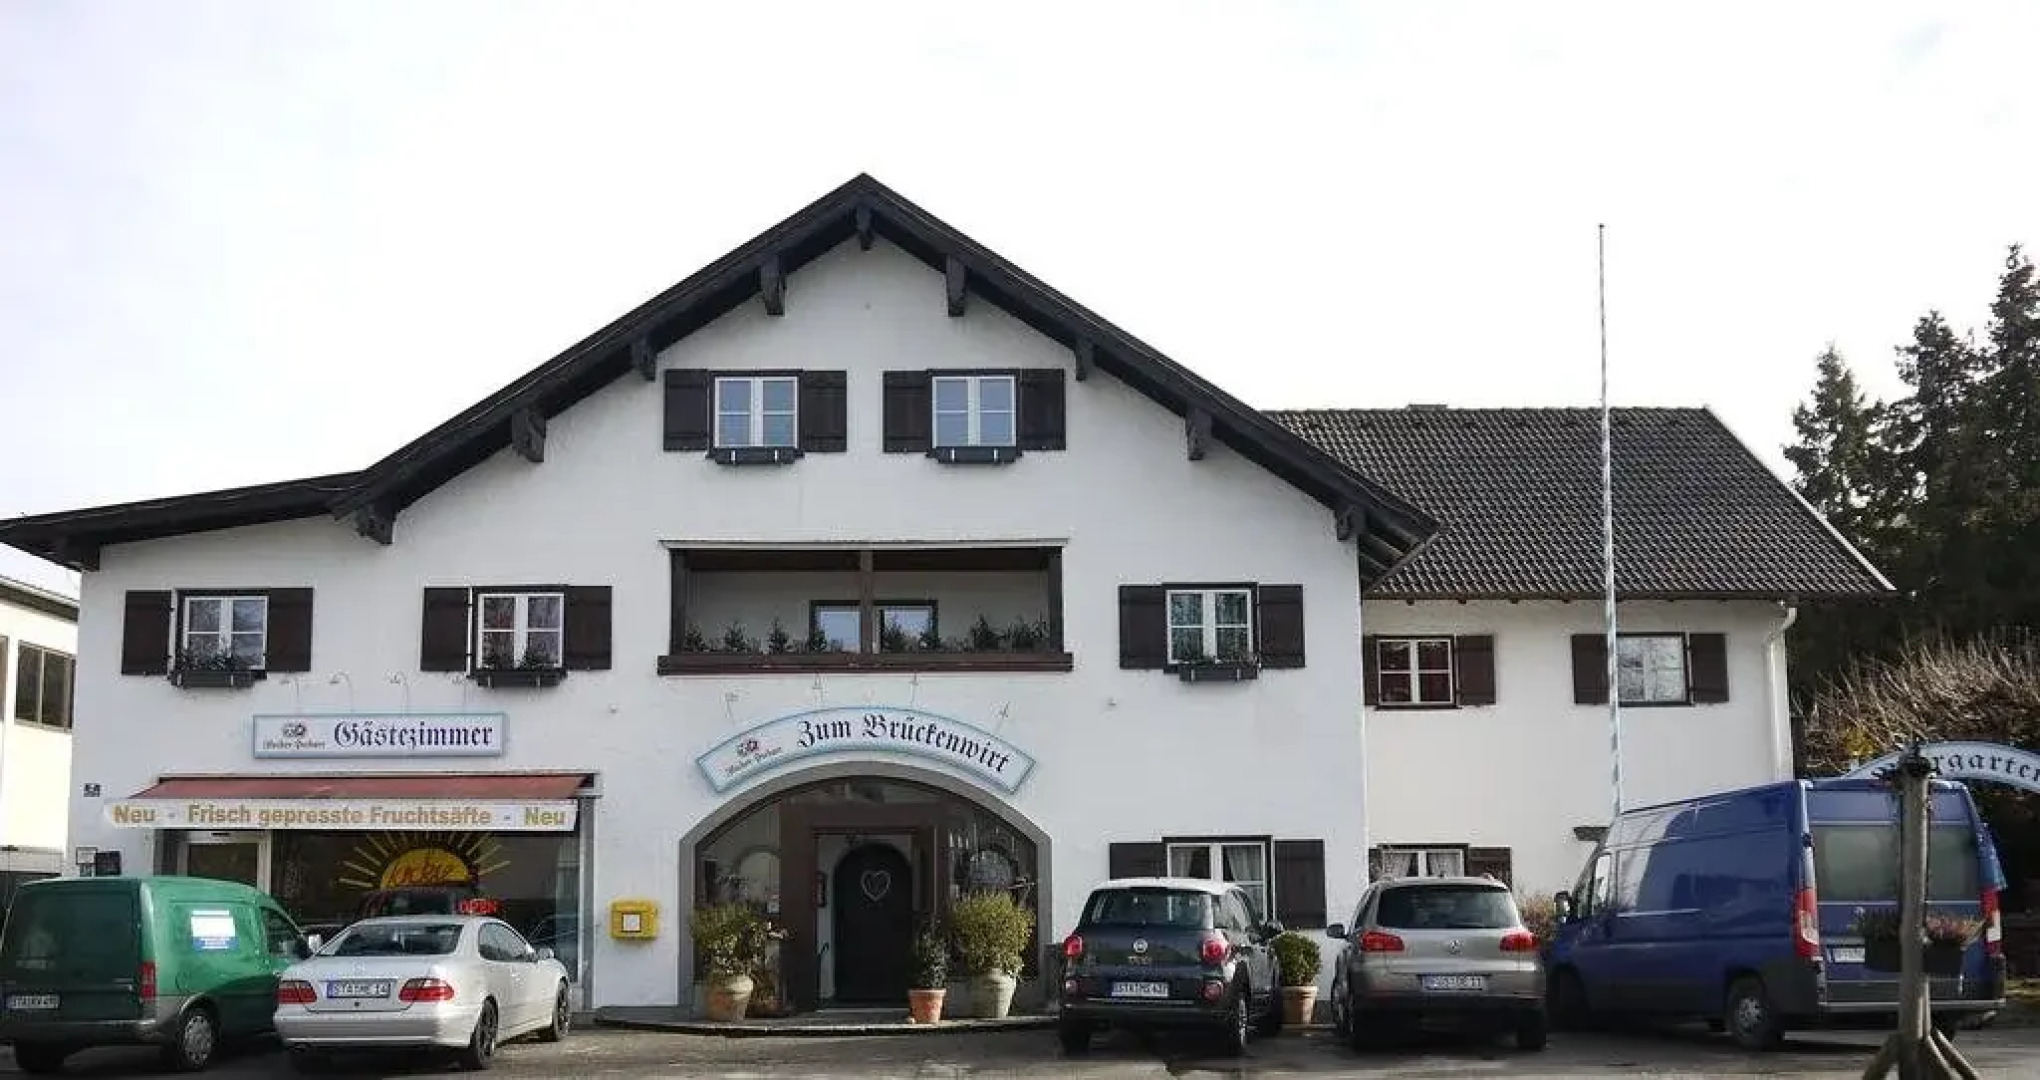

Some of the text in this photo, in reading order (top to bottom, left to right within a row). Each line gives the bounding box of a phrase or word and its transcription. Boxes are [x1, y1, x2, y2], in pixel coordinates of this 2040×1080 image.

[334, 720, 493, 750] Gästezimmer
[798, 714, 1009, 772] Zum Brückenwirt
[113, 805, 155, 823] Neu
[188, 804, 250, 823] Frisch
[258, 806, 363, 827] gepresste
[370, 805, 491, 825] Fruchtsäfte
[525, 807, 565, 825] Neu
[459, 900, 497, 914] OPEN
